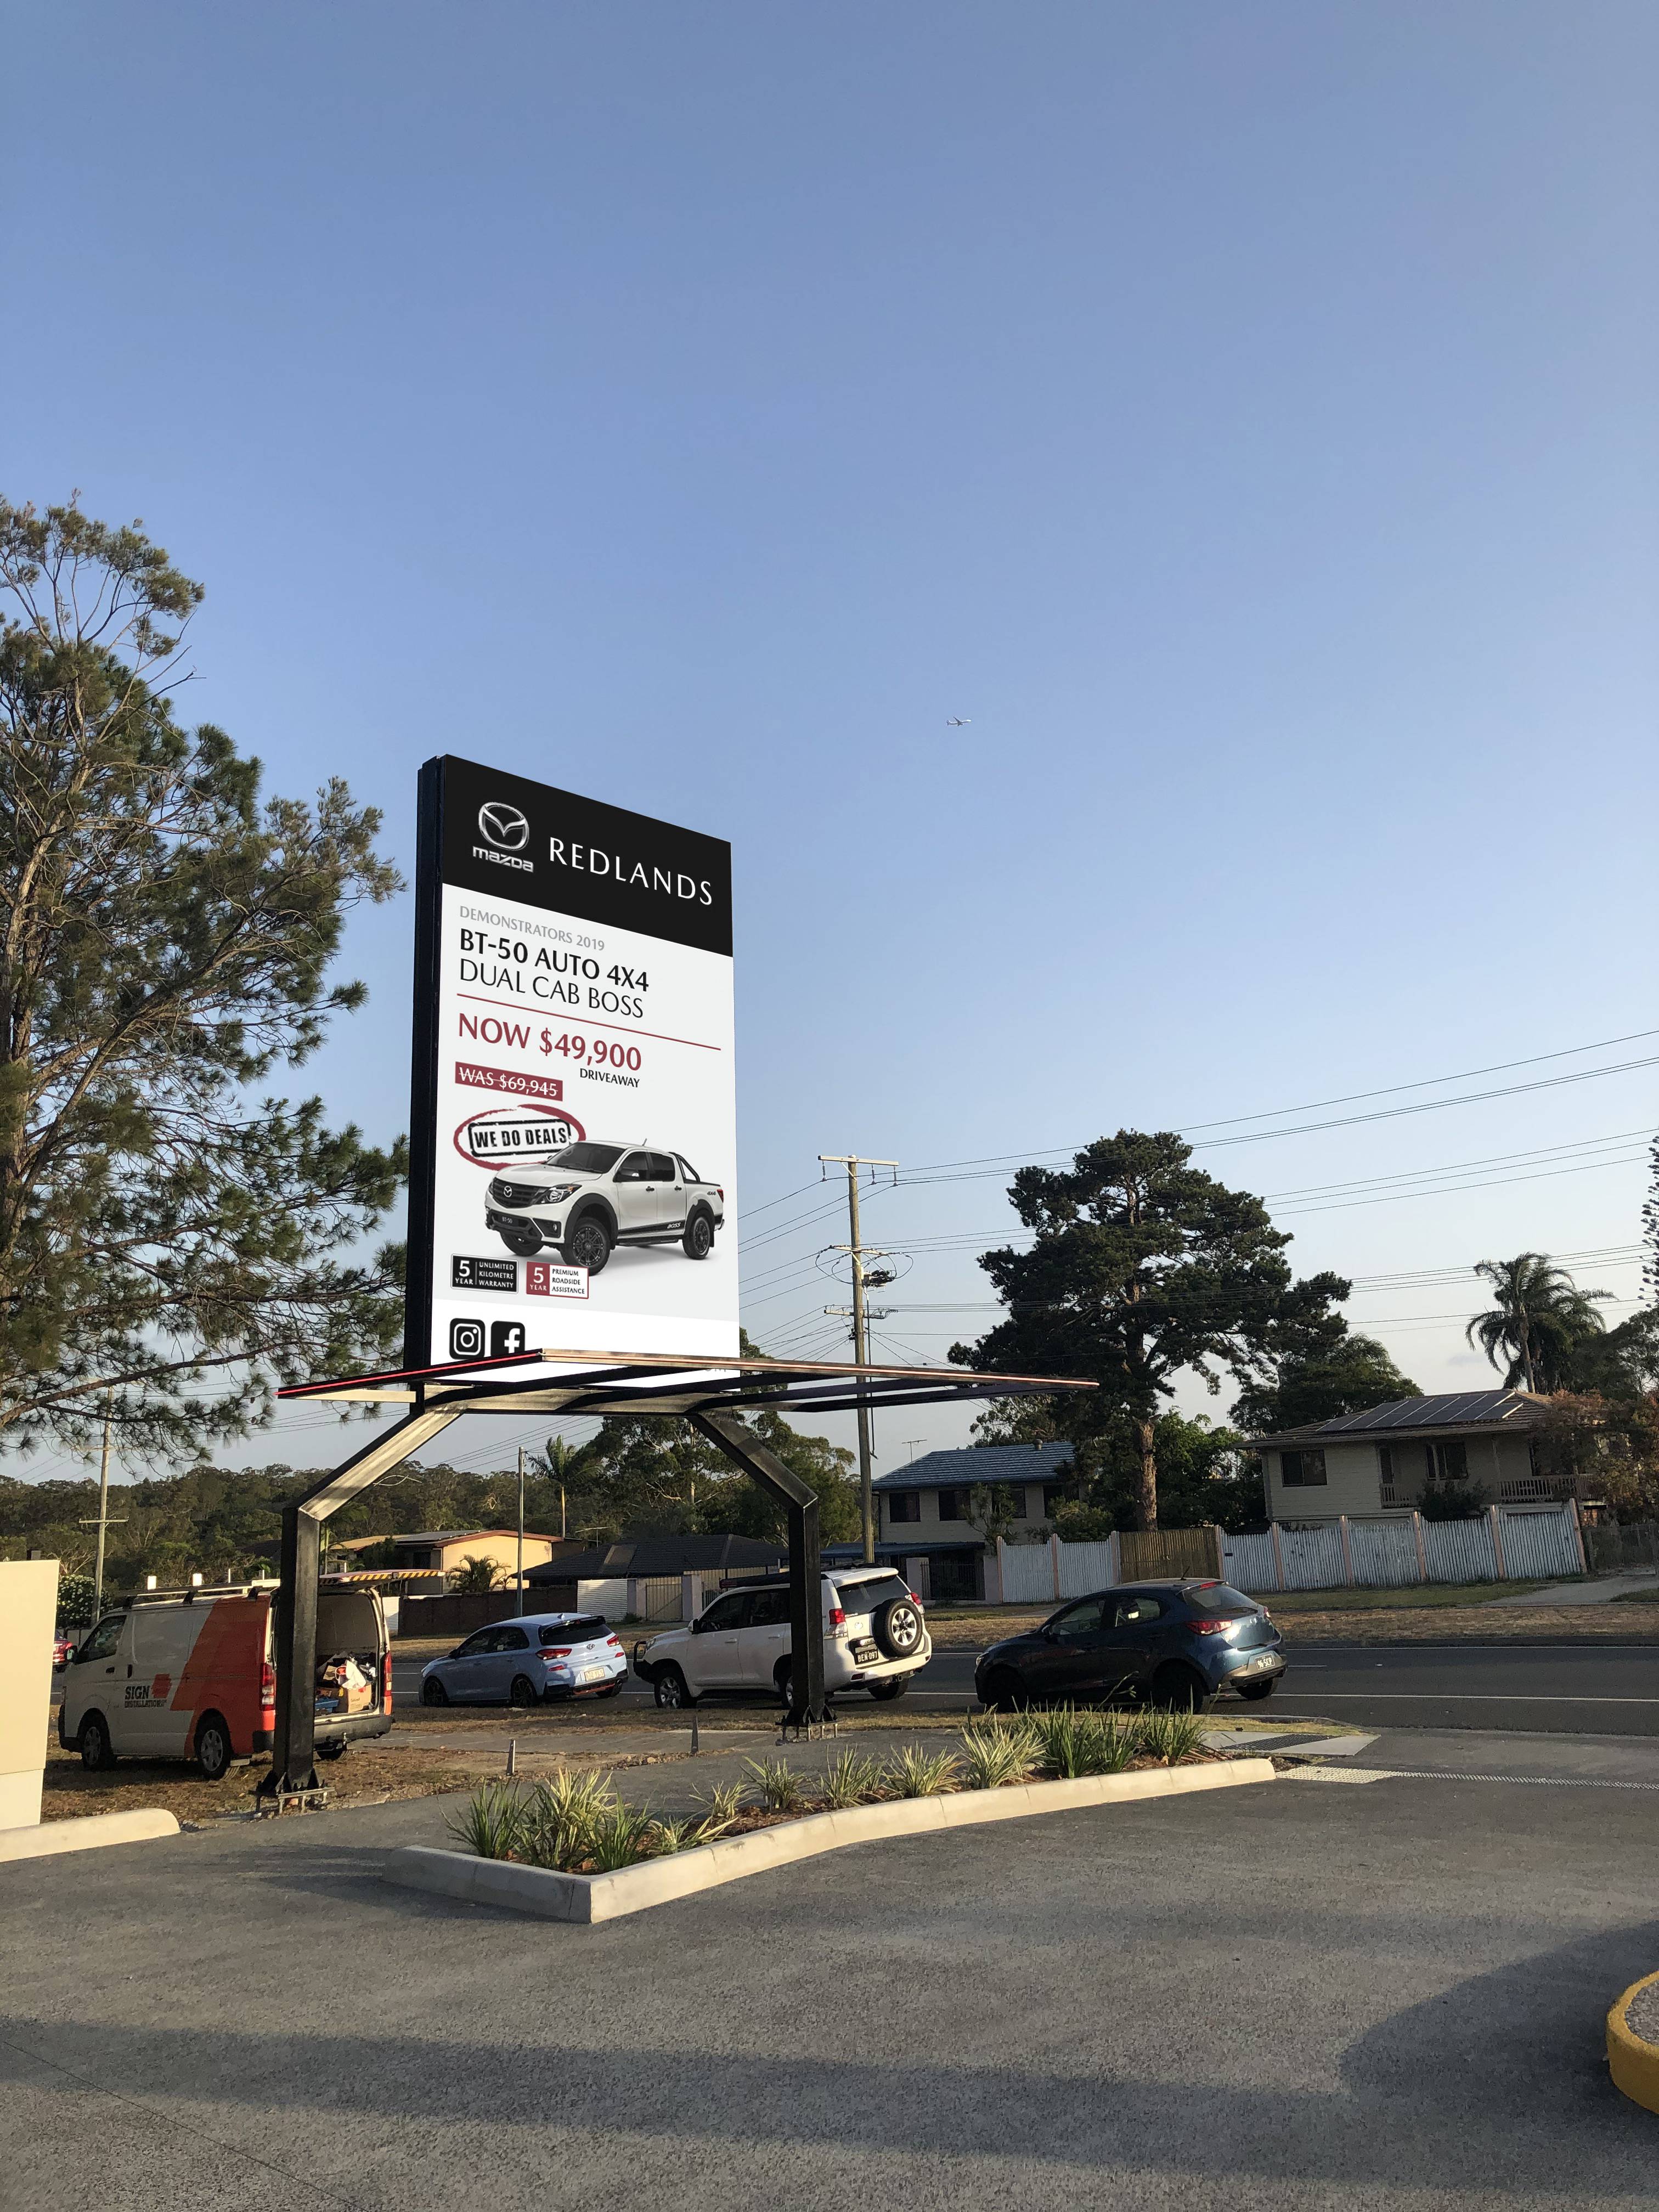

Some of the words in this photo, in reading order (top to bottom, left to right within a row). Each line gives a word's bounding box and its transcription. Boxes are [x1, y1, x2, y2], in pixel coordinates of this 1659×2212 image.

[550, 837, 712, 905] REDLANDS
[460, 905, 573, 944] DEMONSTRATORS
[577, 935, 605, 951] 2019
[460, 928, 528, 963] BT-50
[535, 947, 600, 980] AUTO
[607, 964, 649, 992] 4X4
[460, 958, 526, 994] DUAL
[533, 976, 580, 1005] CAB
[589, 987, 643, 1018] BOSS
[459, 1013, 531, 1049] NOW
[539, 1027, 642, 1070] $49,900
[459, 1067, 494, 1085] WAS
[500, 1073, 557, 1097] $69,945
[580, 1068, 640, 1088] DRIVEAWAY
[474, 1131, 496, 1148] WE
[501, 1130, 520, 1146] DO
[525, 1127, 567, 1145] DEALS
[459, 1260, 470, 1277] 5
[479, 1262, 514, 1270] UNLIMITED
[479, 1271, 514, 1279] KILOMETRE
[533, 1267, 544, 1283] 5
[479, 1280, 514, 1288] WARRANTY
[552, 1286, 585, 1294] ASSISTANCE
[125, 1685, 150, 1699] SIGN
